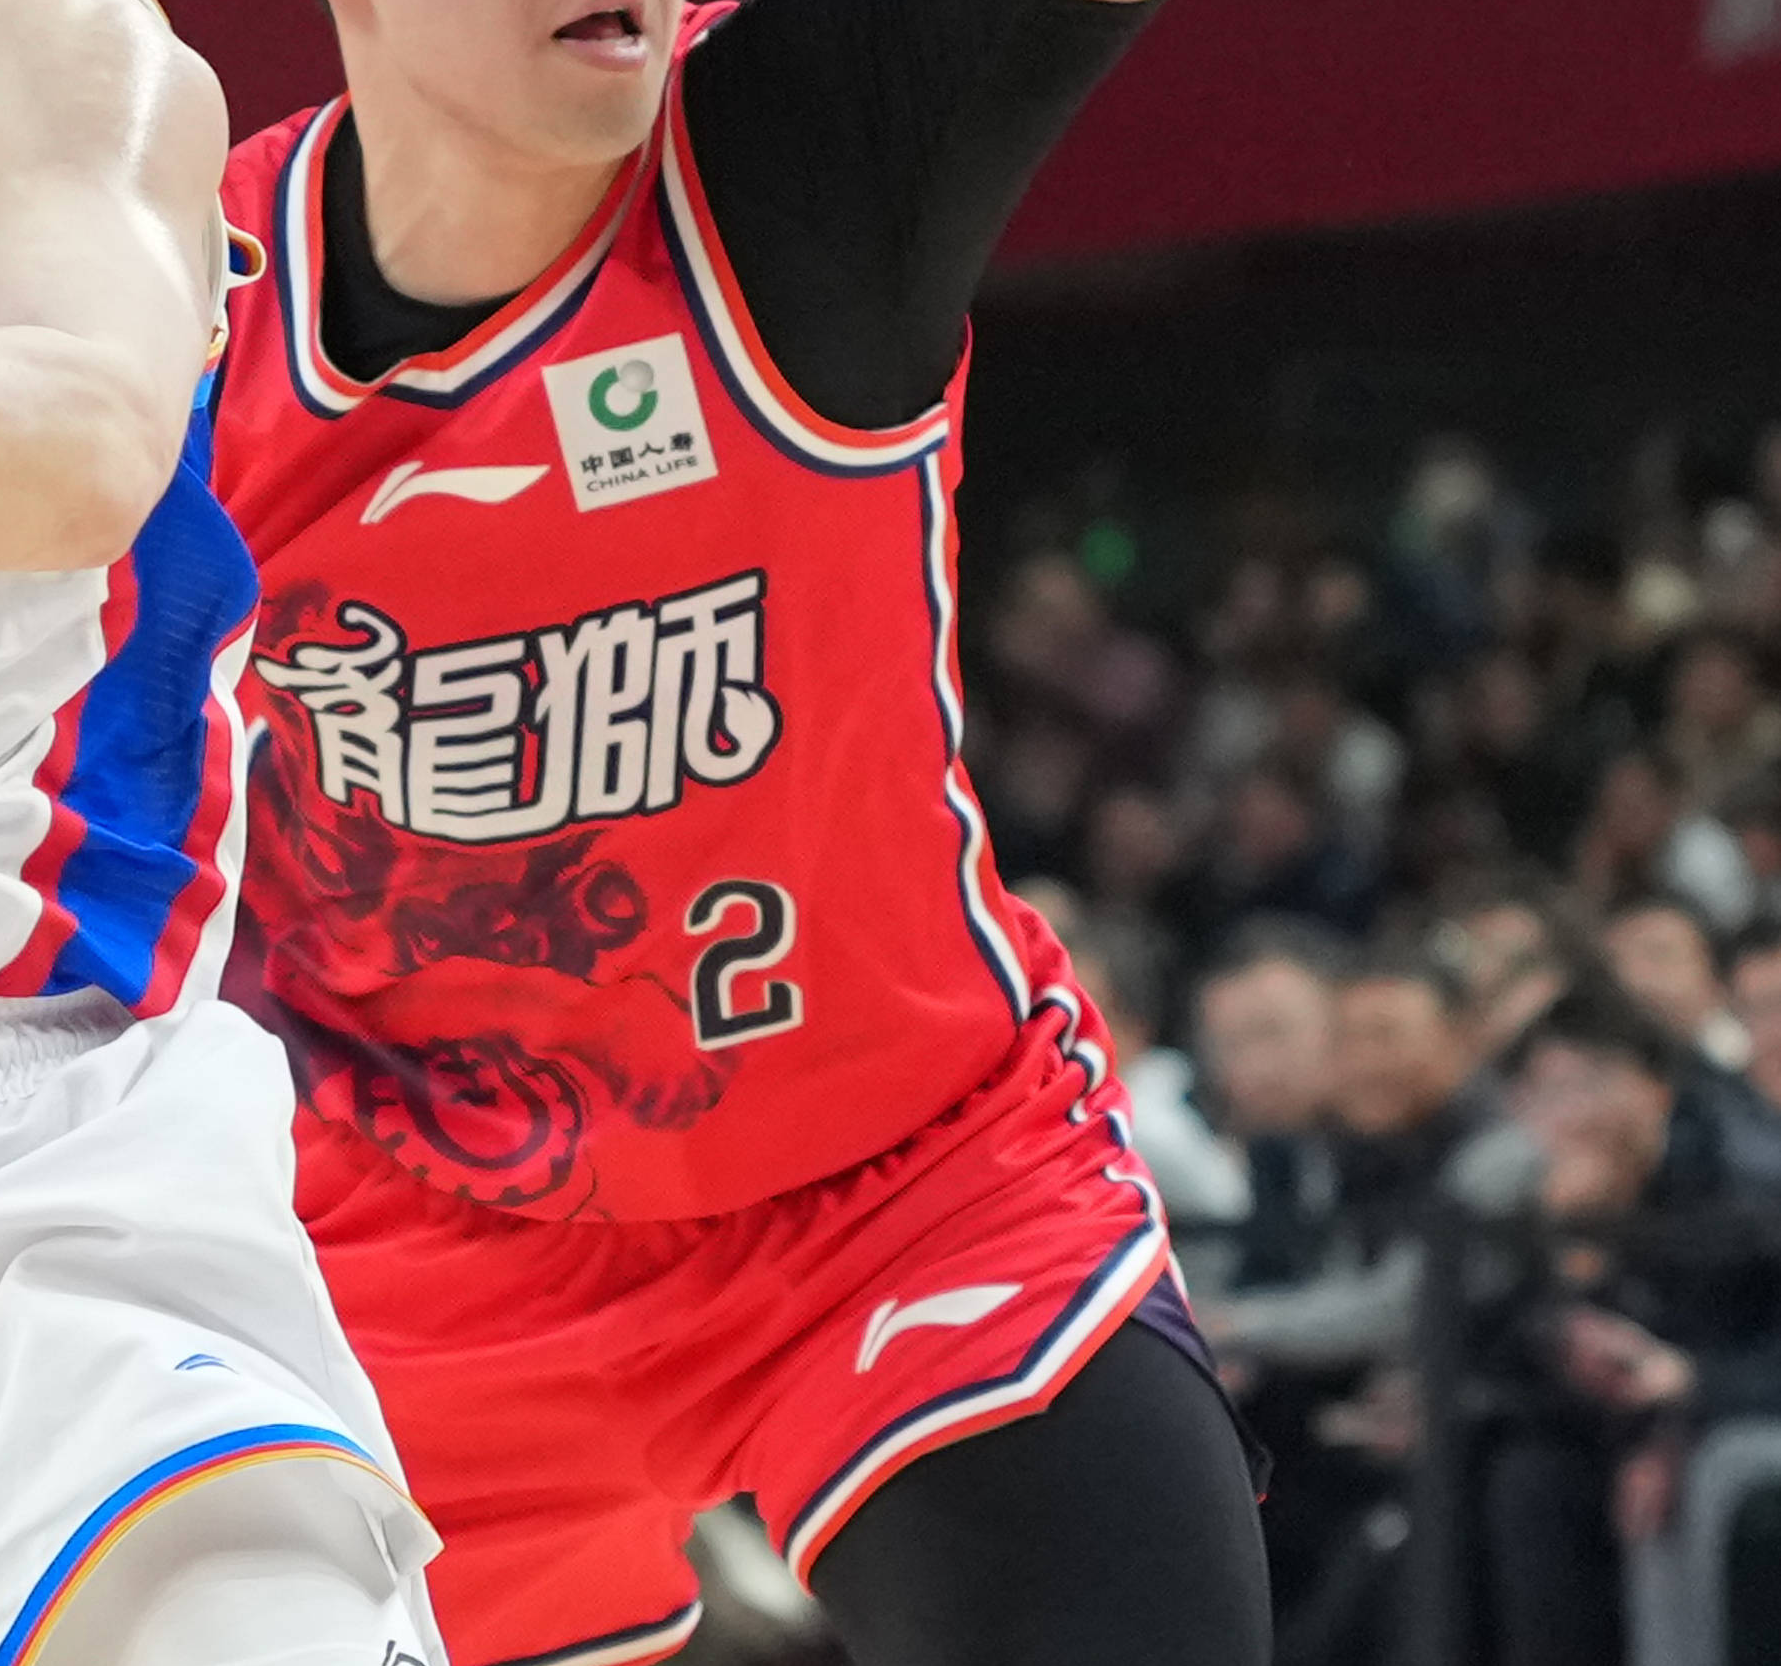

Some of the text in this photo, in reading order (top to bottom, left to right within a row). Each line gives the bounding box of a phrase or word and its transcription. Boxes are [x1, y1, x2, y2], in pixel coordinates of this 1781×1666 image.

[586, 454, 699, 492] CHINA LIFE
[684, 878, 804, 1052] 2
